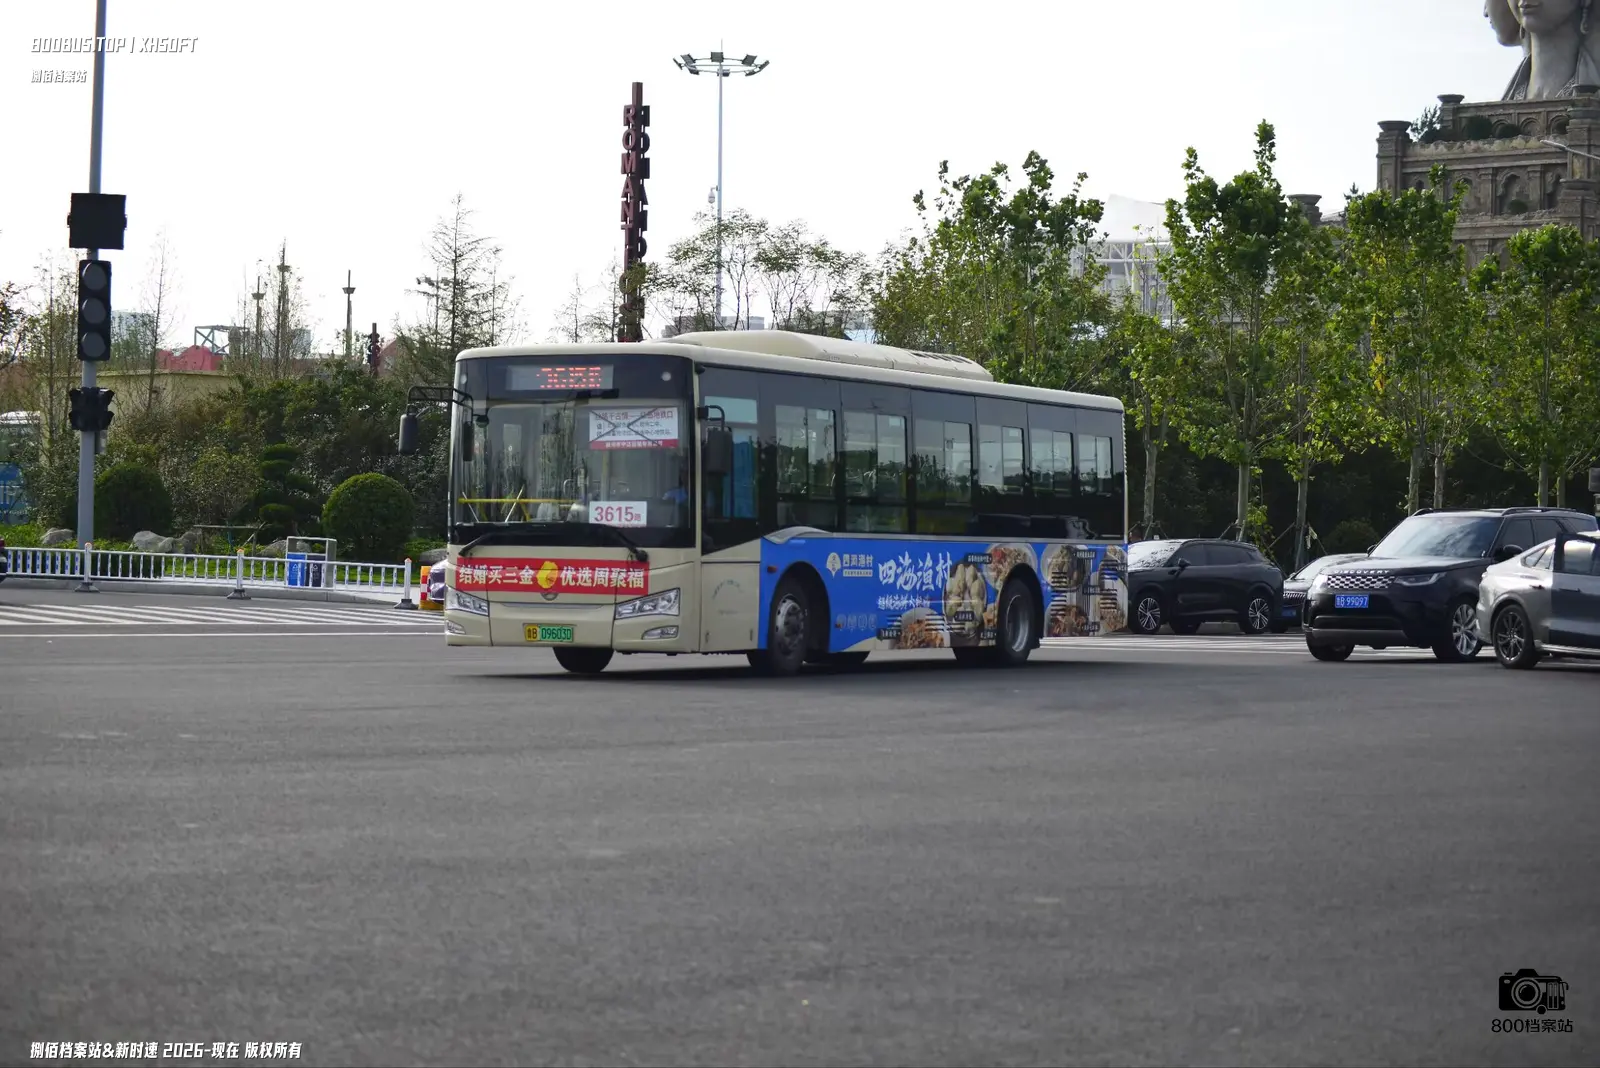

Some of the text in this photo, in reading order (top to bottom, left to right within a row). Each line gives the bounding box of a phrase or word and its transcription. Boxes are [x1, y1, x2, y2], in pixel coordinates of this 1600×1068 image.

[458, 564, 645, 589] 结婚买三金 优选周聚福
